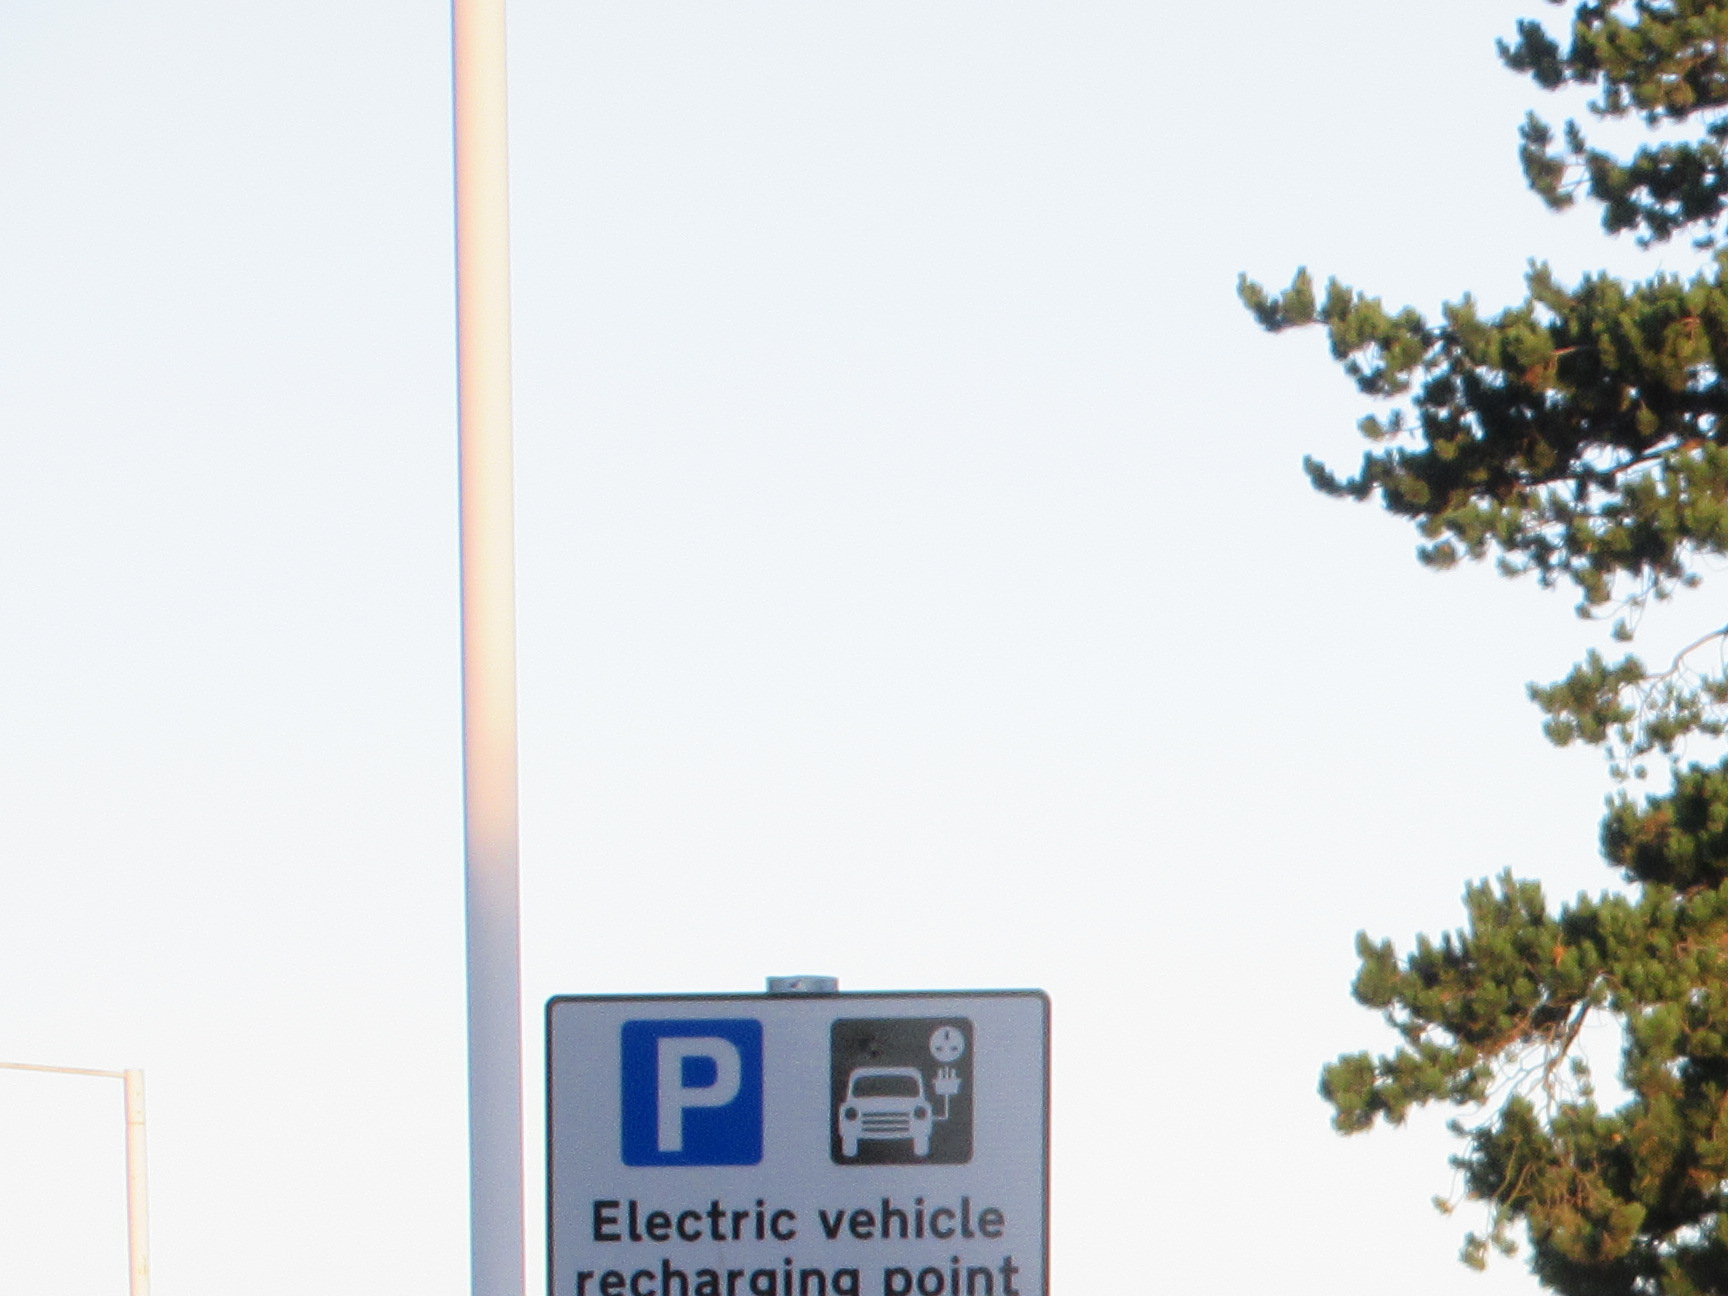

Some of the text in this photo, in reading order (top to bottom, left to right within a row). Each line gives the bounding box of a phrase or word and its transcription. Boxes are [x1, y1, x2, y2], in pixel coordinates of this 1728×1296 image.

[657, 1036, 742, 1152] P
[592, 1197, 1004, 1243] Electric vehicle
